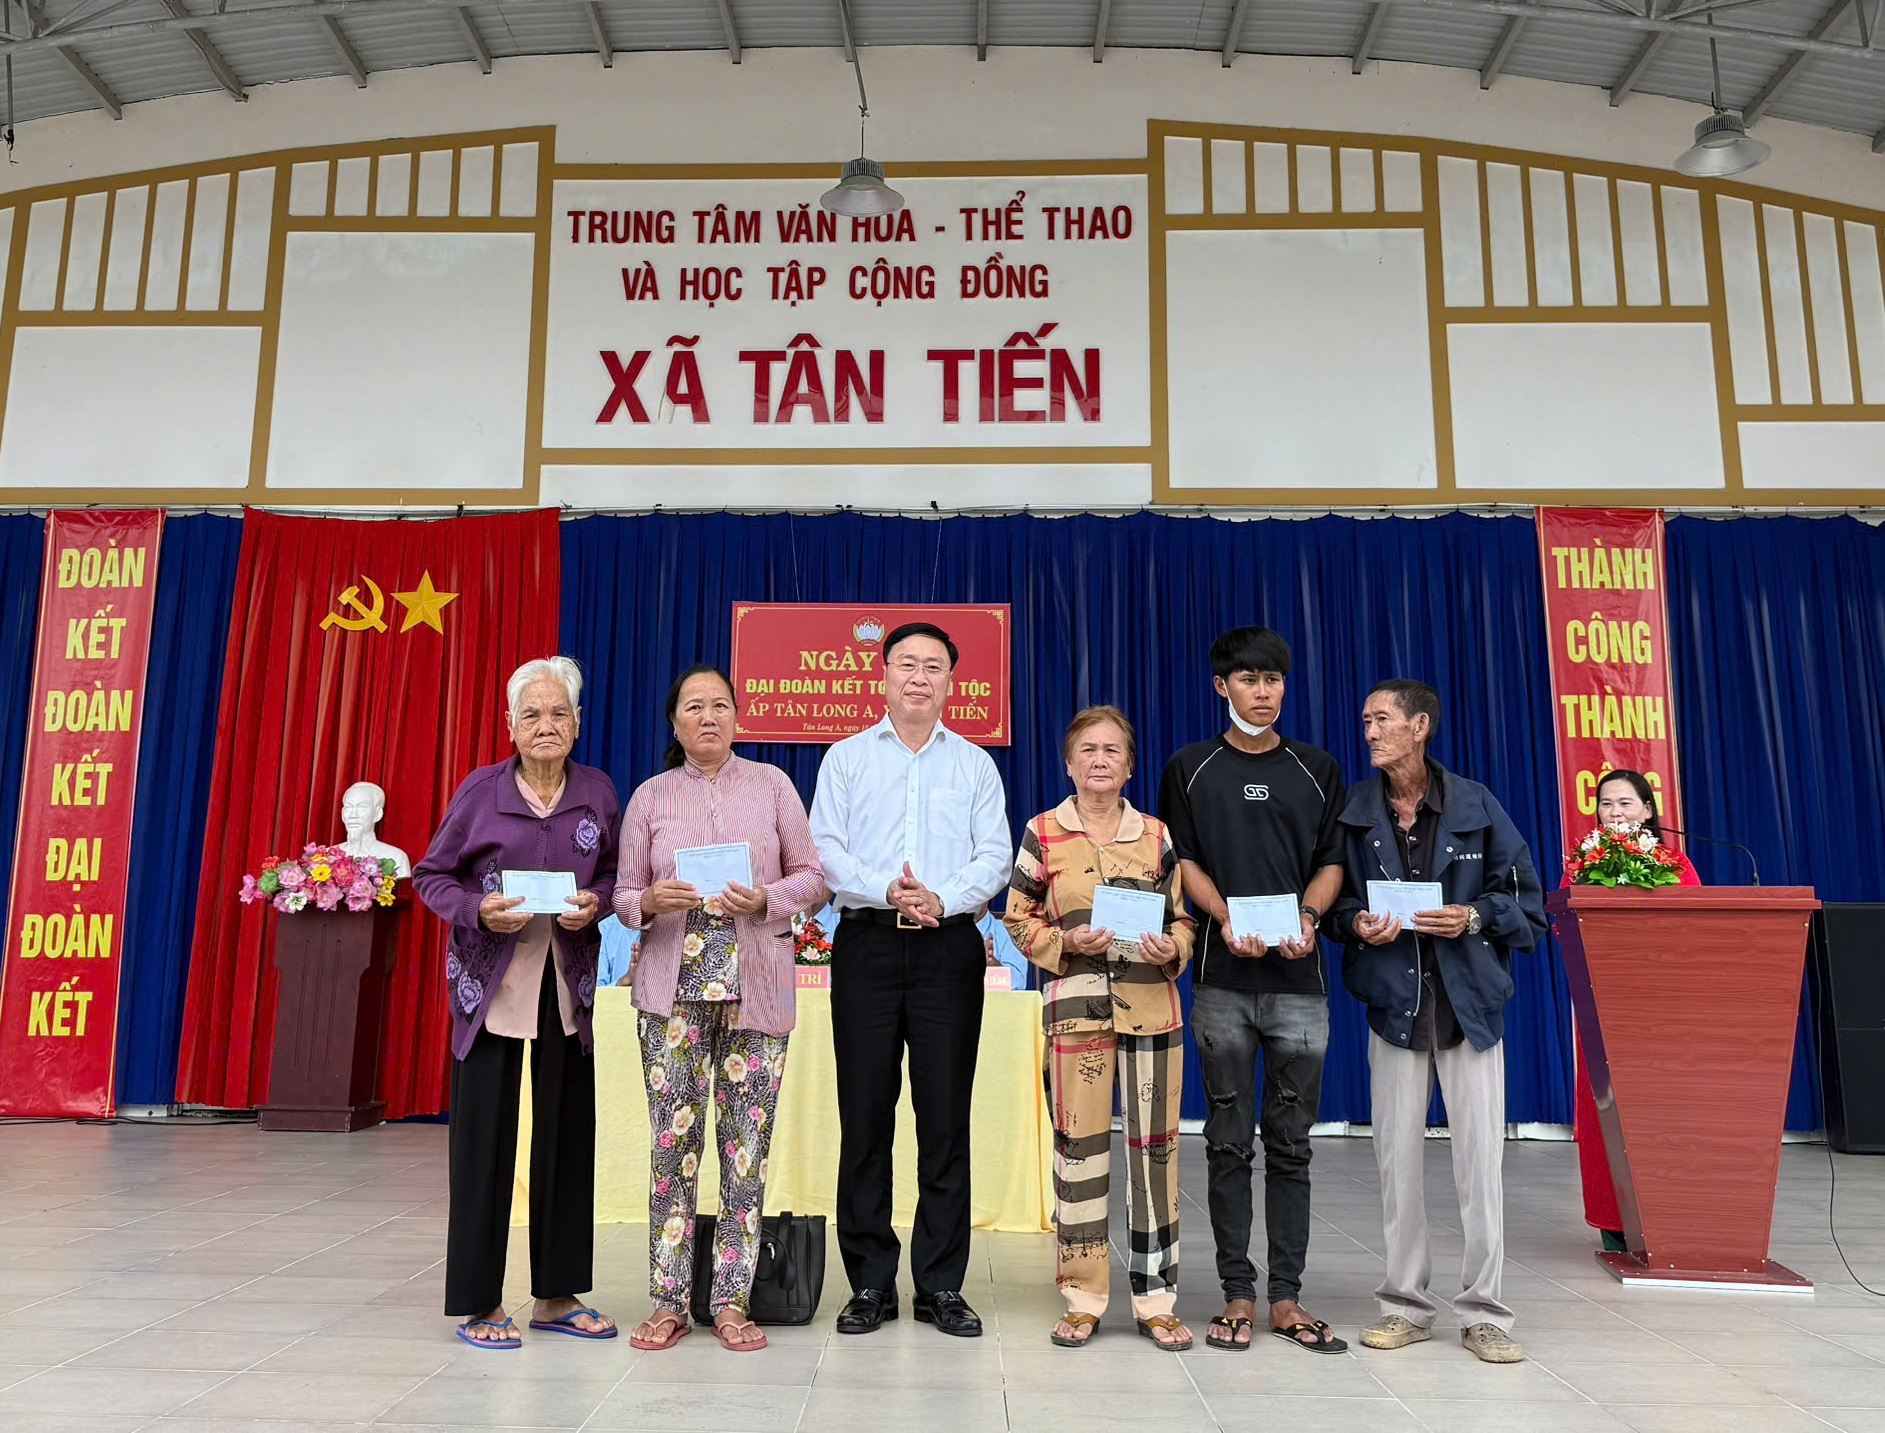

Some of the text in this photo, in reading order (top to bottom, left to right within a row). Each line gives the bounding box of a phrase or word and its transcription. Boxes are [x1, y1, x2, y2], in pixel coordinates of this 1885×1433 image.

[568, 210, 675, 244] TRUNG
[693, 204, 761, 243] TÂM
[776, 204, 837, 243] VĂN
[960, 190, 1025, 241] THỂ
[1043, 206, 1133, 240] THAO
[622, 252, 1049, 308] VÀ HỌC TẬP CỘNG ĐỒNG
[596, 323, 1101, 424] XÃ TÂN TIẾN
[58, 540, 145, 588] ĐOÀN
[1551, 538, 1655, 590] THÀNH
[65, 604, 127, 660] KẾT
[799, 645, 878, 671] NGÀY
[1566, 611, 1653, 664] CÔNG
[44, 681, 133, 733] ĐOÀN
[745, 679, 774, 696] ĐẠI
[779, 676, 826, 694] ĐOÀN
[832, 676, 863, 694] KẾT
[958, 679, 991, 700] TỘC
[746, 697, 769, 717] ẤP
[774, 700, 808, 717] TÂN
[812, 703, 858, 718] LONG
[862, 705, 878, 720] A,
[948, 701, 989, 720] TIẾN
[1561, 685, 1666, 740] THÀNH
[817, 723, 834, 732] Long
[51, 748, 113, 806] KẾT
[1576, 762, 1664, 817] CG
[45, 837, 102, 892] ĐẠI
[20, 904, 113, 958] ĐOÀN
[28, 976, 92, 1037] KẾT
